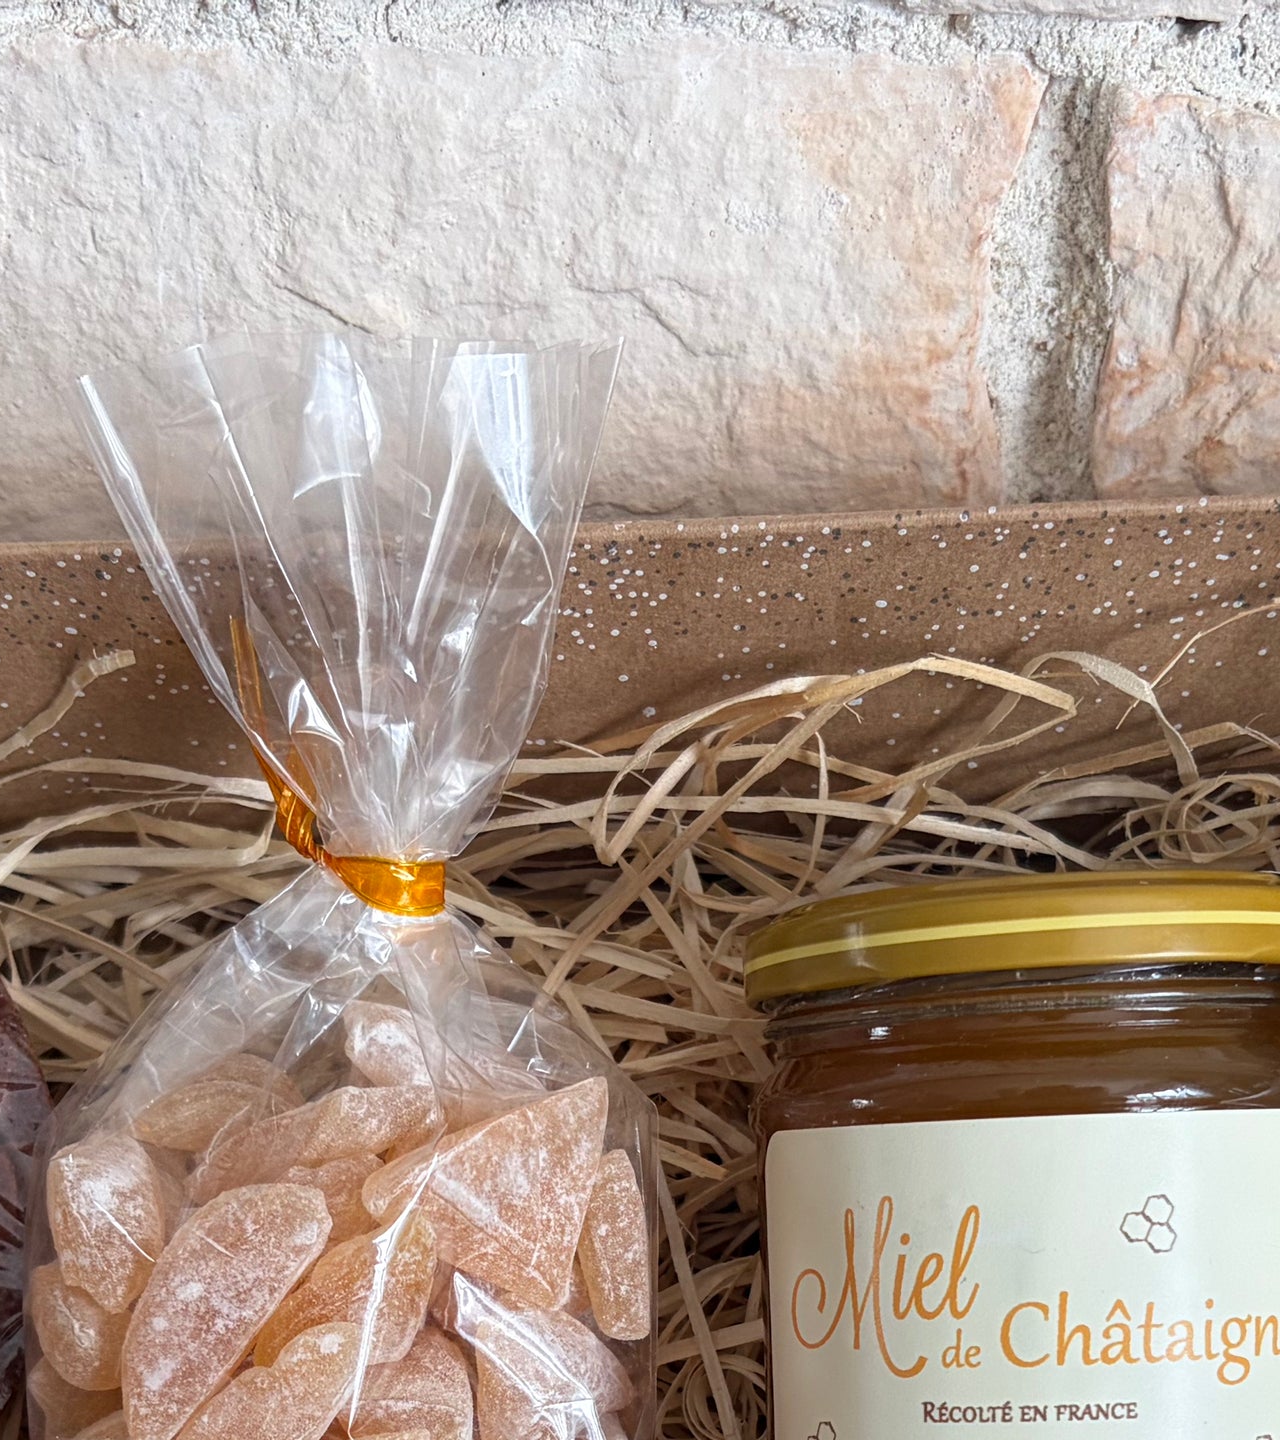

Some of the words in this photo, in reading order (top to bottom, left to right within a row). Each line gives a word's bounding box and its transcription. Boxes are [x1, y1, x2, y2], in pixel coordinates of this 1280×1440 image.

[791, 1195, 980, 1379] Miel
[941, 1328, 982, 1369] de
[921, 1400, 1013, 1424] RÉCOLTÉ
[1019, 1404, 1048, 1423] EN
[1054, 1401, 1138, 1422] FRANCE
